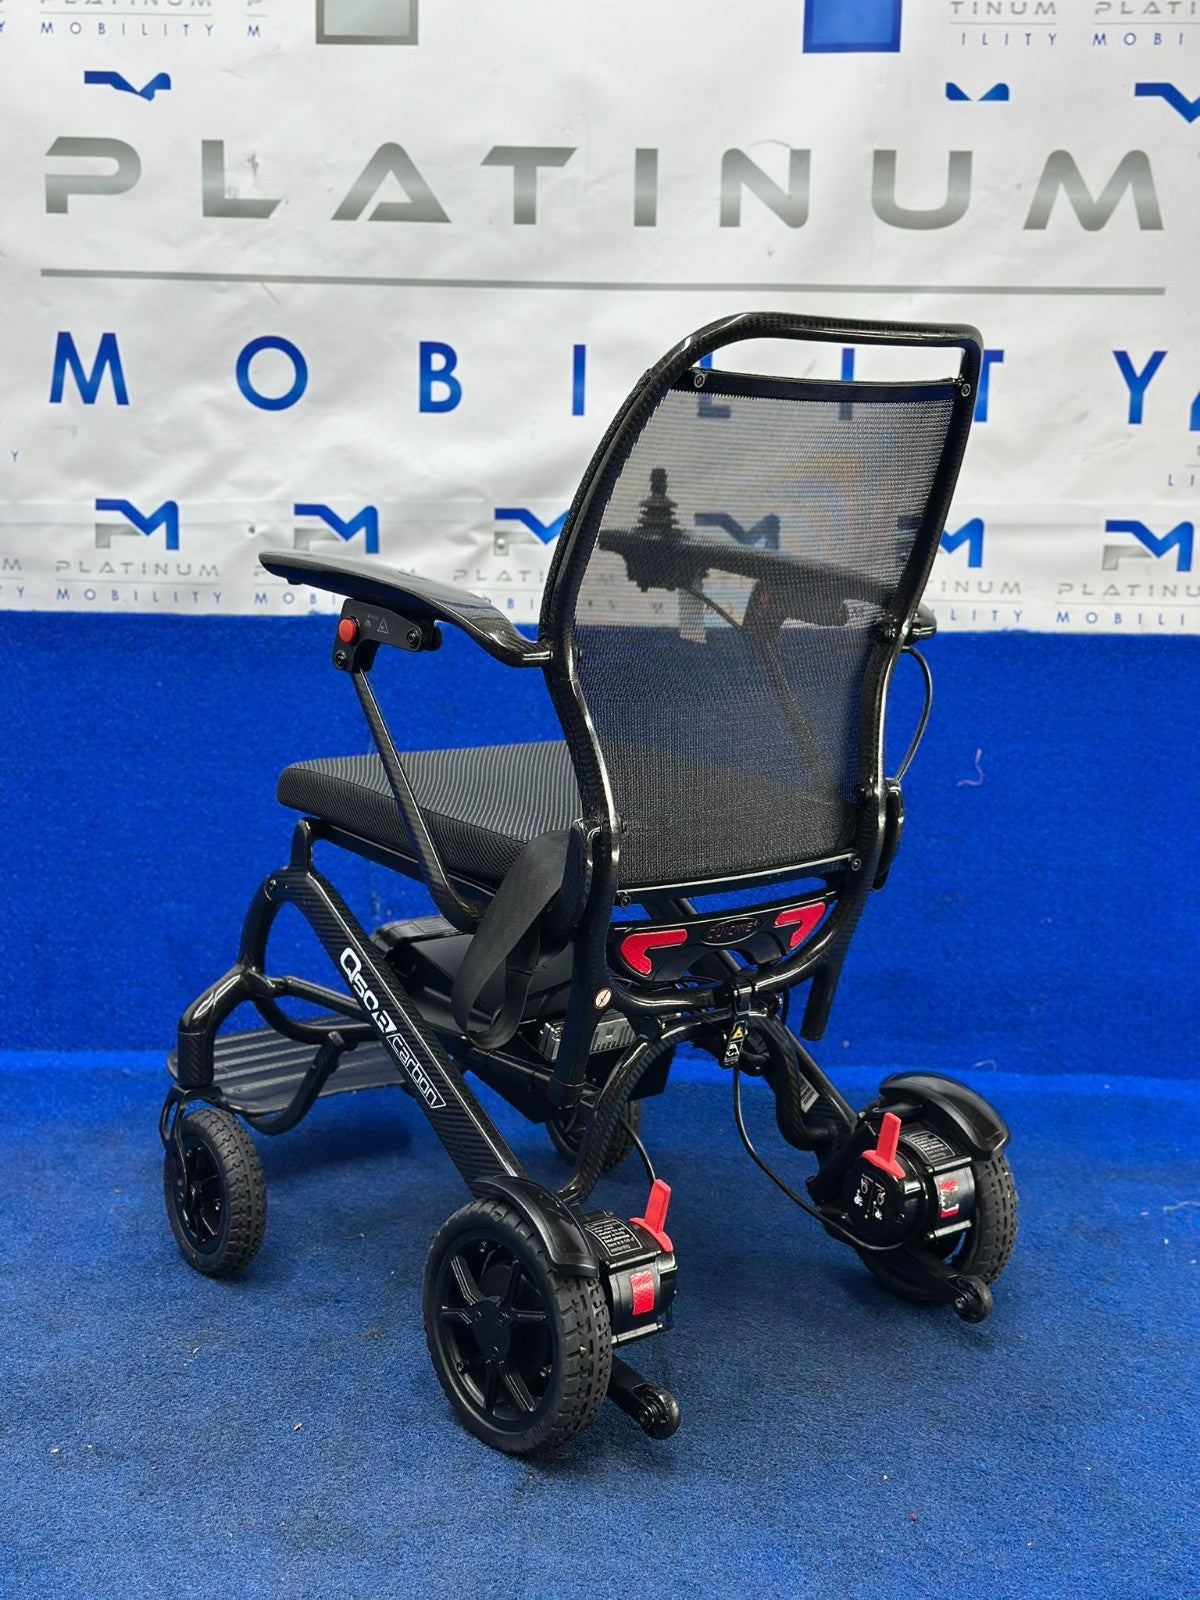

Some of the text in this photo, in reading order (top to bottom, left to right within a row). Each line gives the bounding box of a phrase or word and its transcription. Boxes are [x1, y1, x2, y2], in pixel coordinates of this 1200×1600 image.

[41, 22, 213, 36] MOBILITY
[1093, 33, 1183, 46] MOBI
[45, 136, 1164, 231] PLATINUM
[50, 331, 1168, 424] MOBILITY
[56, 560, 220, 577] PLATINUM
[929, 580, 1021, 595] INUM
[57, 588, 223, 604] MOBILITY
[931, 609, 1023, 622] LITY
[390, 1034, 442, 1108] carbon
